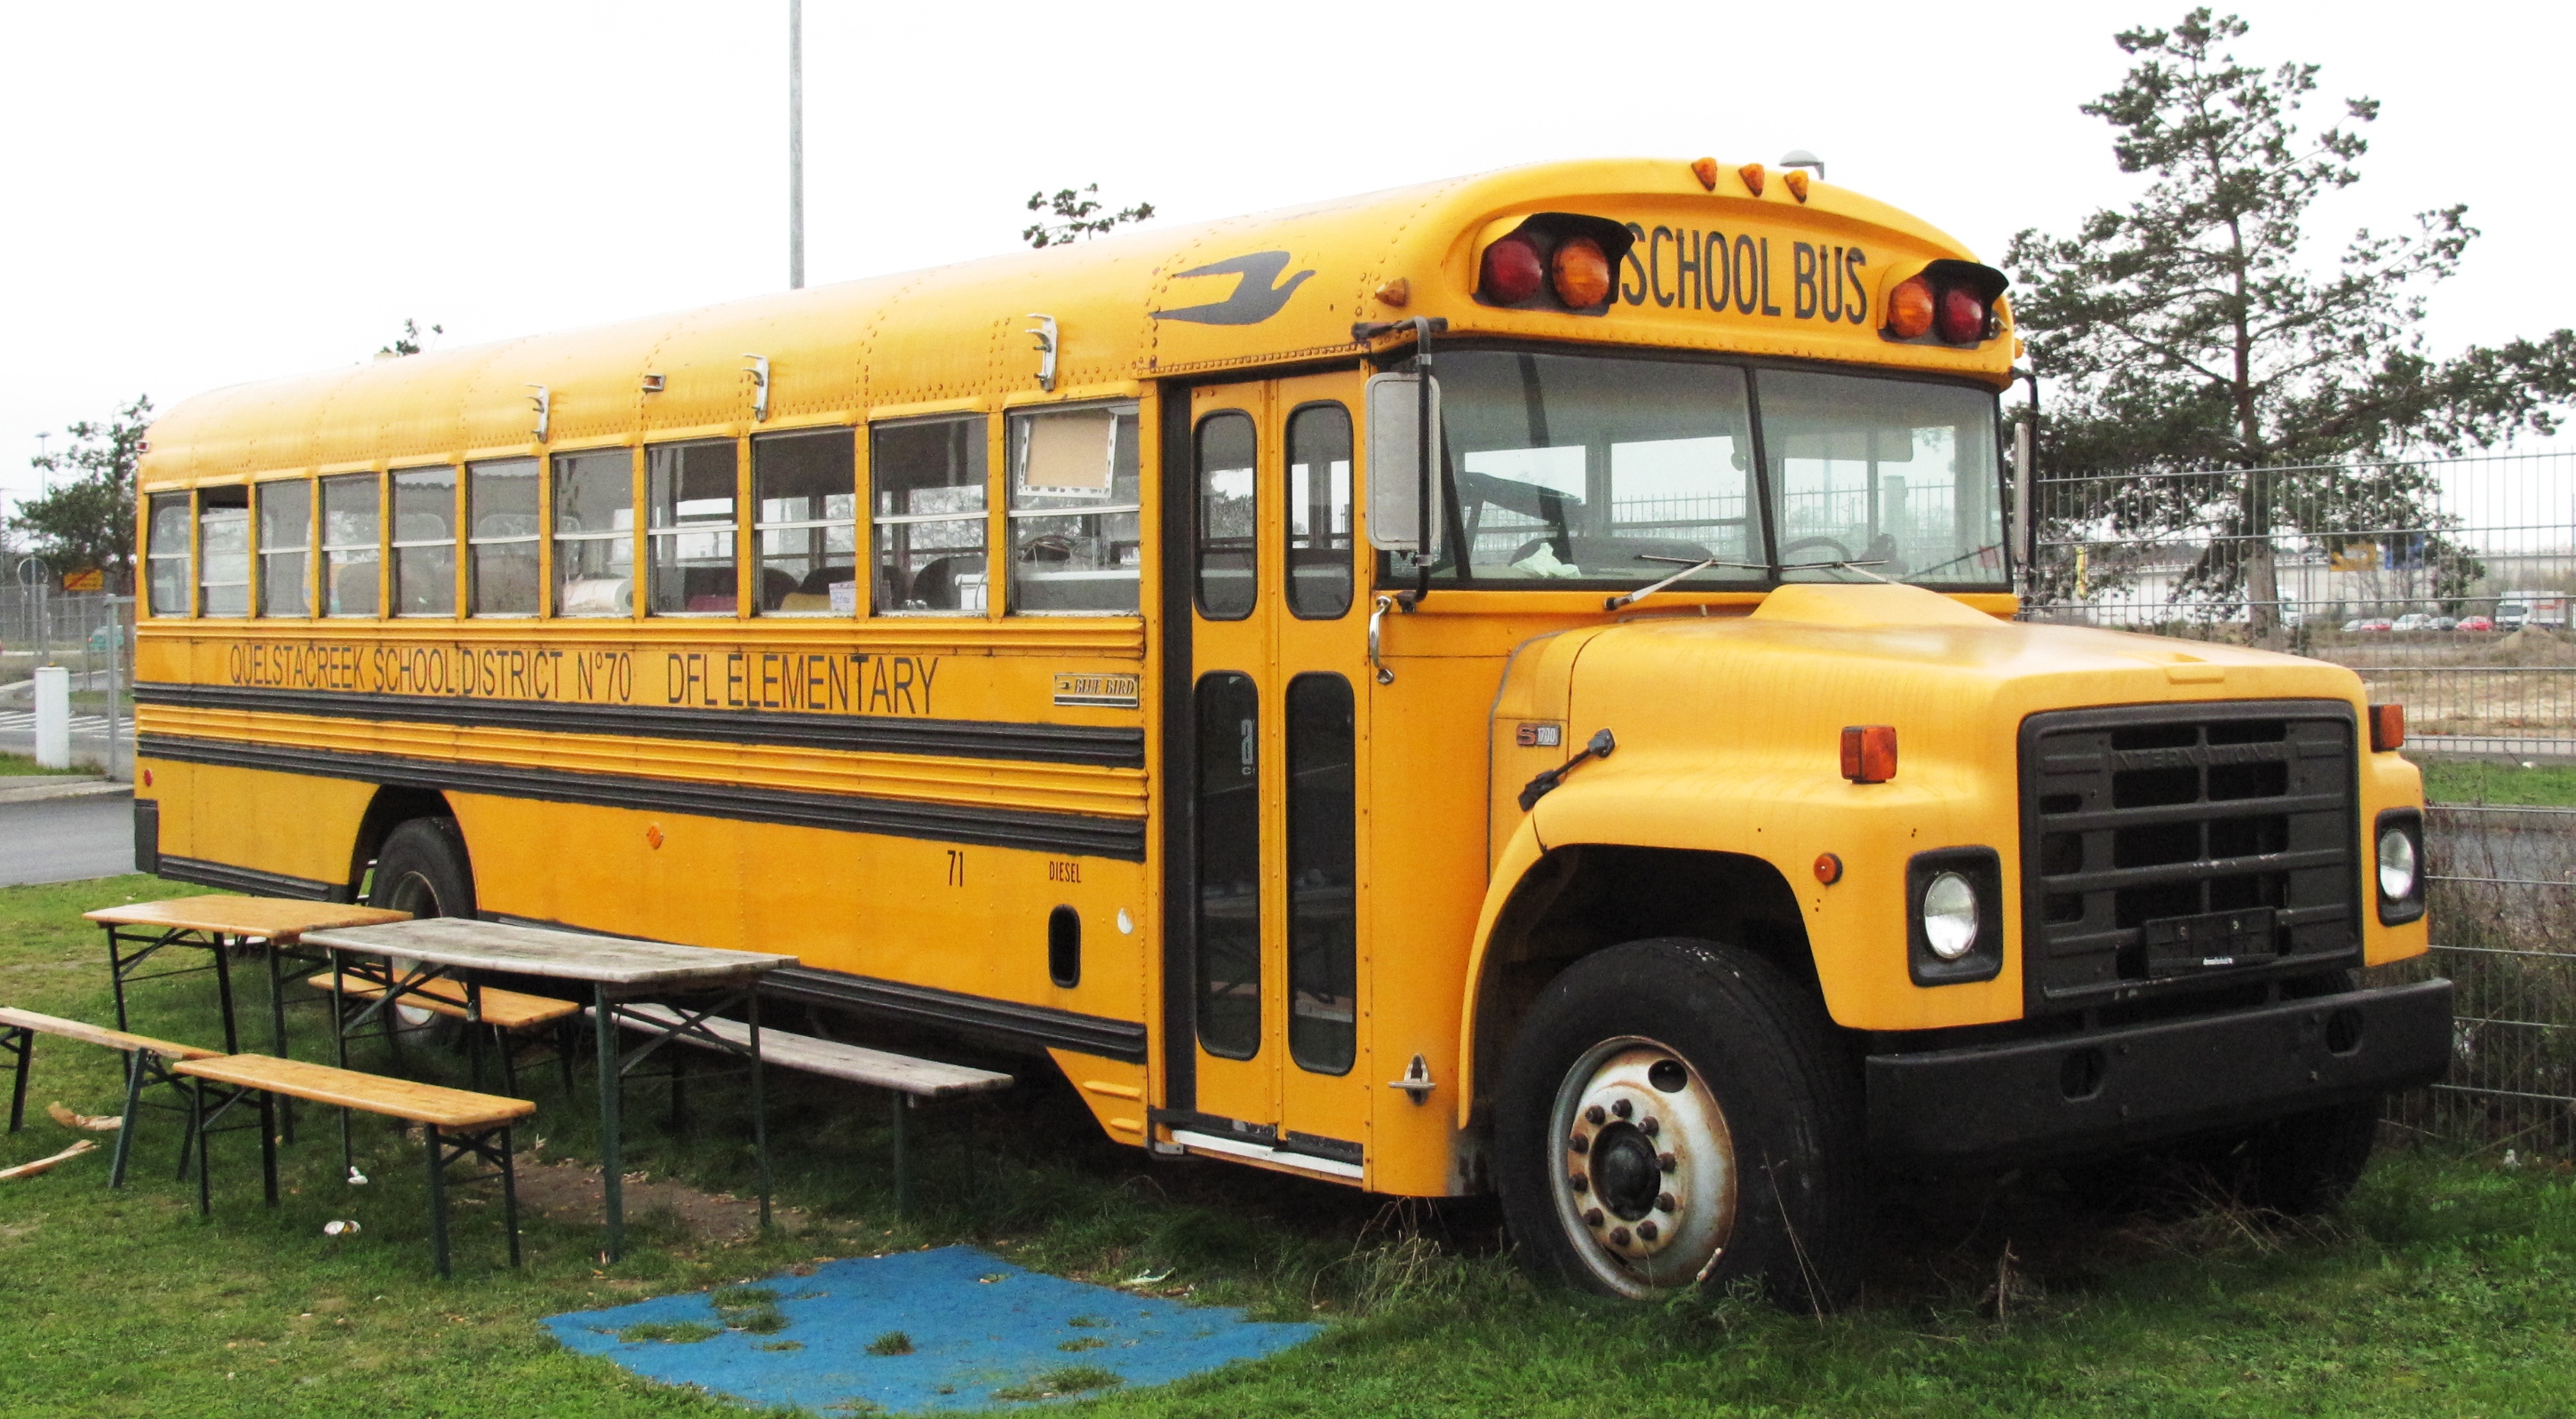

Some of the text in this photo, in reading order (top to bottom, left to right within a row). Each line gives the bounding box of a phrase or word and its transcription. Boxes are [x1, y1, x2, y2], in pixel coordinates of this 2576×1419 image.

[1621, 221, 1868, 326] SCHOOL BUS
[372, 647, 456, 695] SCHOOL
[461, 650, 562, 700] DISTRICT
[667, 652, 718, 706] DFL
[727, 654, 940, 714] ELEMENTARY
[1075, 678, 1134, 695] BLUE BIRD
[947, 850, 964, 887] 71
[1050, 860, 1082, 883] DIESEL
